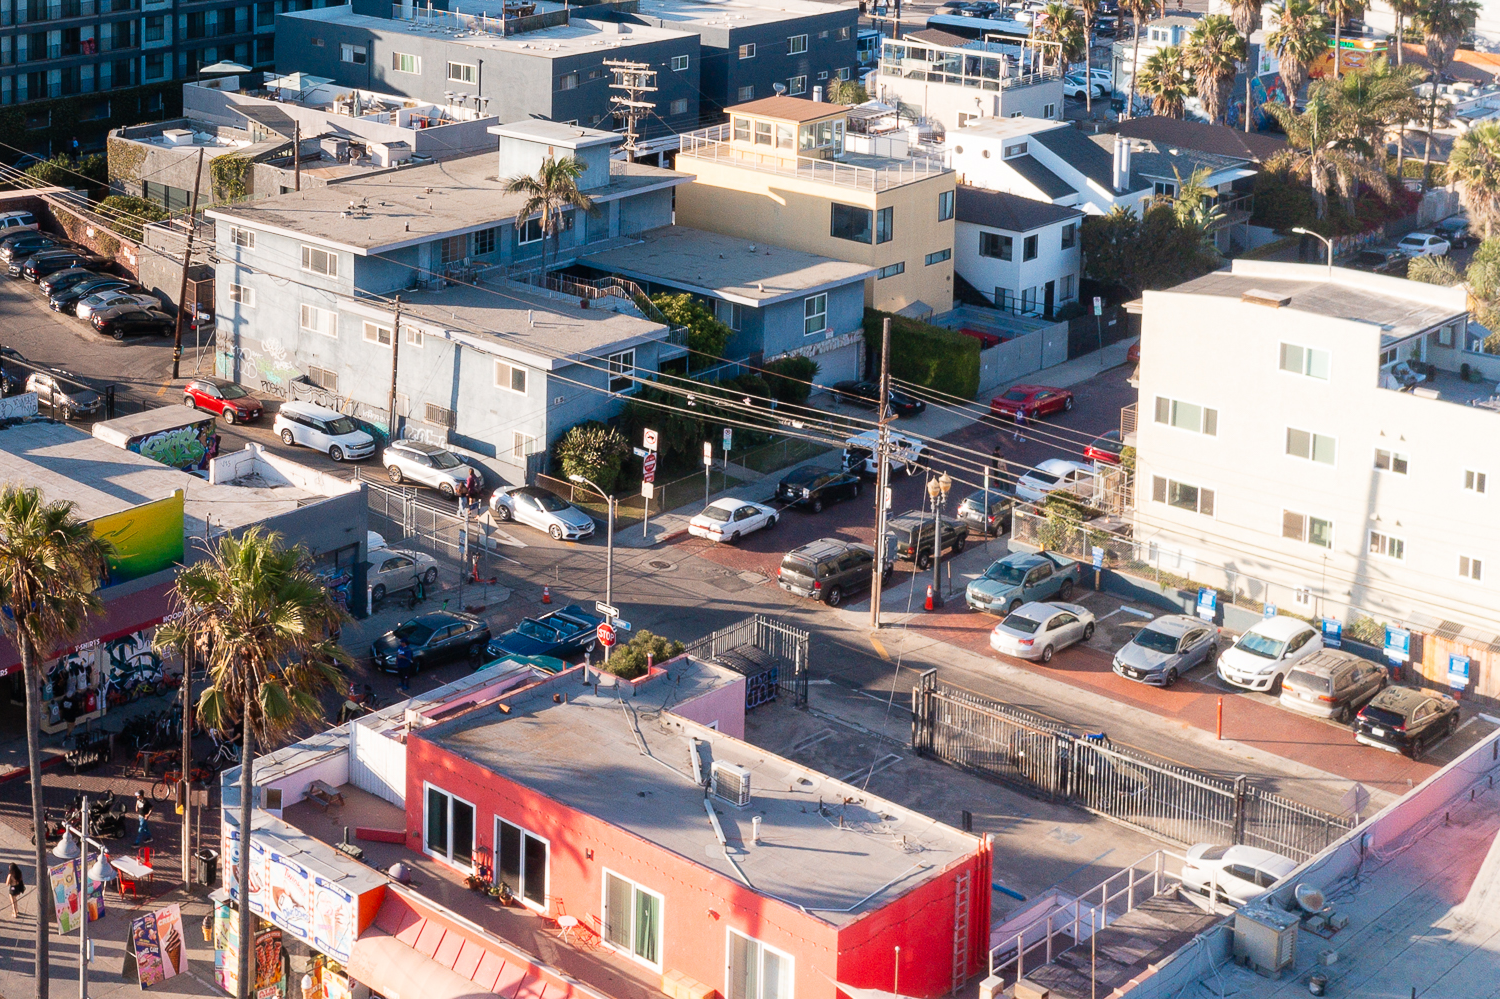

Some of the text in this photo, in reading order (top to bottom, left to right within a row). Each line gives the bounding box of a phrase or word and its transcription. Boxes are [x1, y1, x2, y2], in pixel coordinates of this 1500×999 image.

[598, 629, 615, 641] STOP
[162, 907, 173, 919] ICE
[158, 912, 181, 927] CREAM
